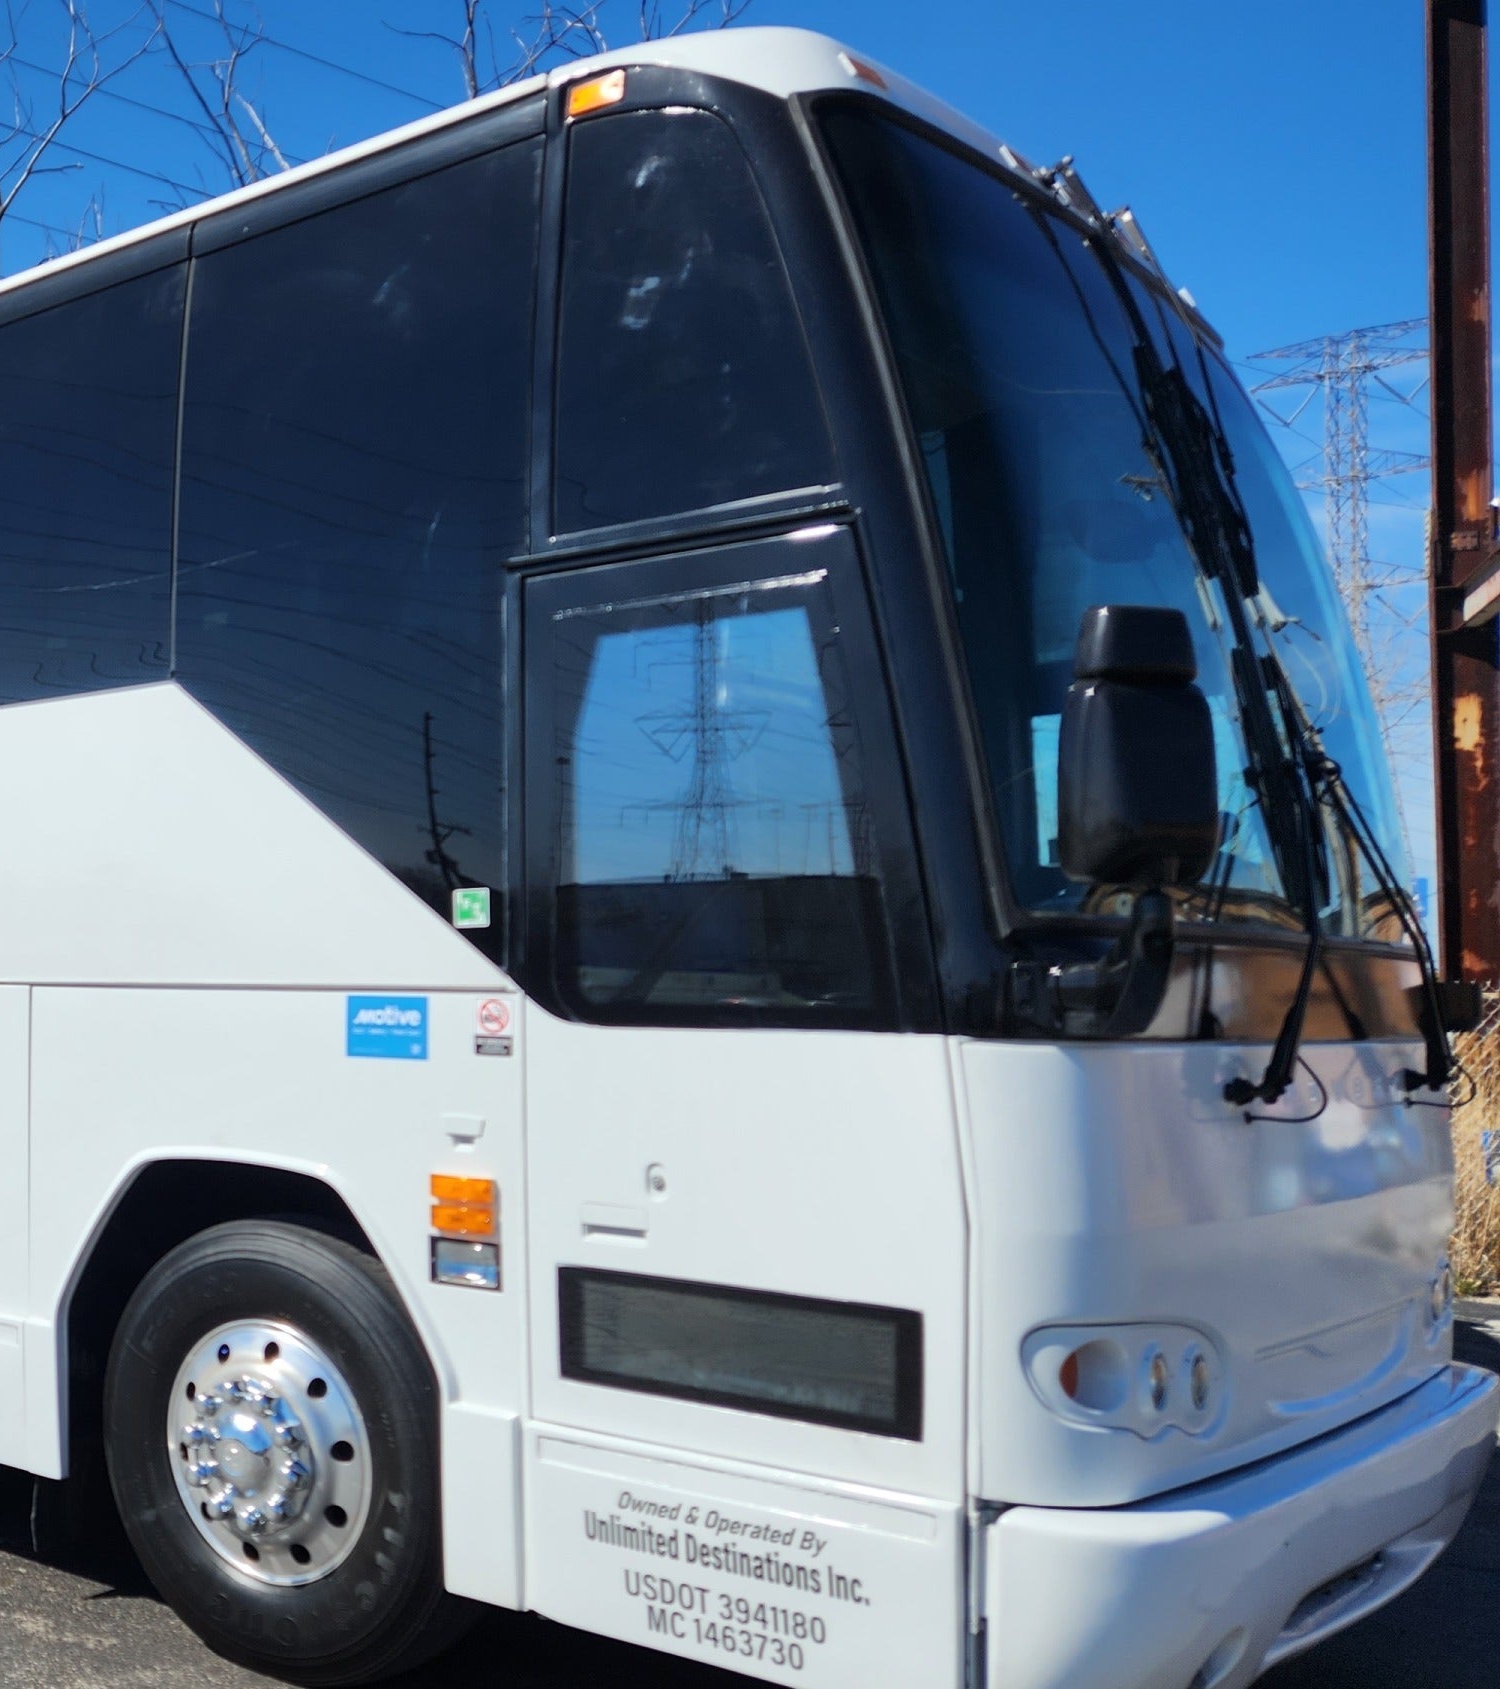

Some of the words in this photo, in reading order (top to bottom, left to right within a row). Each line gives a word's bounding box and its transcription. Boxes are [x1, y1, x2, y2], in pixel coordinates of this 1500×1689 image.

[584, 1510, 680, 1560] Unlimited
[685, 1533, 822, 1594] Destinations
[827, 1566, 871, 1606] Inc.
[618, 1491, 681, 1521] Owned
[684, 1506, 699, 1525] &
[704, 1510, 796, 1547] Operated
[800, 1531, 828, 1558] By
[624, 1569, 711, 1614] USDOT
[719, 1594, 827, 1645] 3941180
[647, 1606, 687, 1640] MC
[693, 1618, 805, 1670] 1463730
